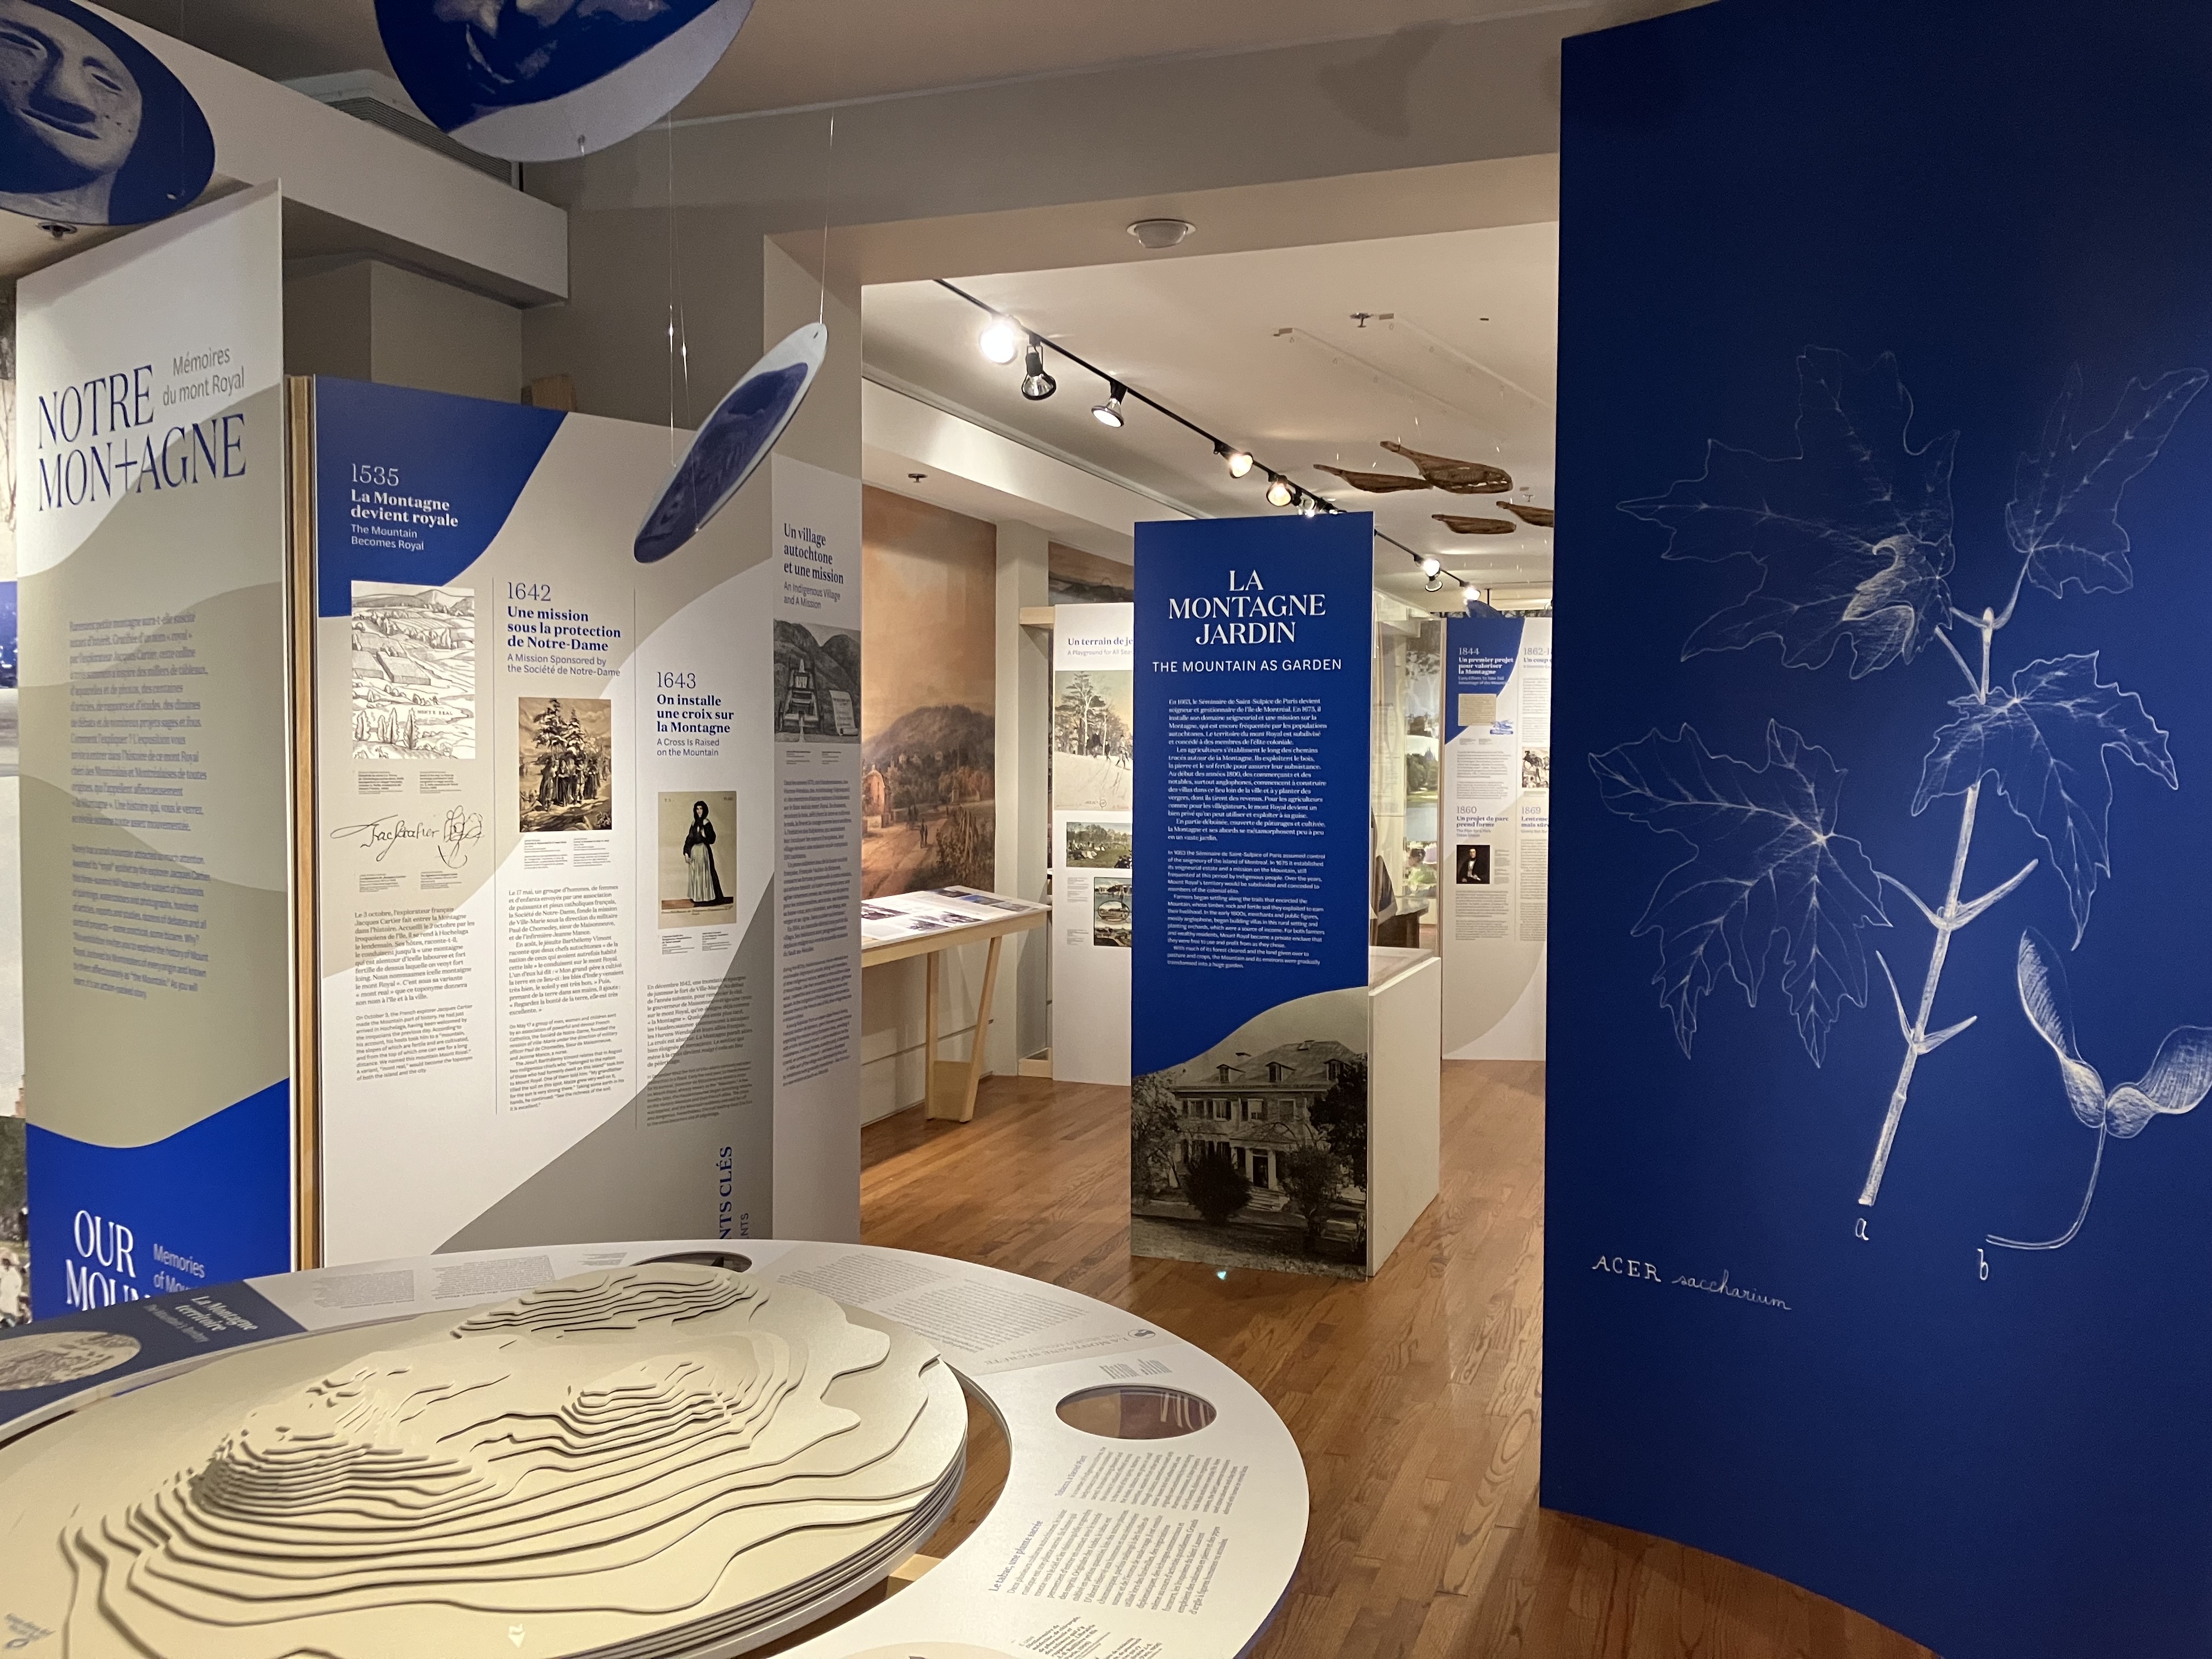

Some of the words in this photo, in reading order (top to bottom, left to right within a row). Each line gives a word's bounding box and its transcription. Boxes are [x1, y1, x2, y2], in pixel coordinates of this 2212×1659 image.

[173, 347, 230, 376] Mémoires
[163, 385, 176, 406] du
[179, 381, 210, 403] mont
[212, 366, 245, 397] Royal
[38, 364, 154, 449] NOTRE
[352, 464, 399, 486] 1535
[352, 489, 370, 503] La
[374, 492, 450, 512] Montagne
[351, 505, 410, 522] devient
[413, 514, 459, 528] royale
[351, 524, 369, 534] The
[371, 526, 417, 538] Mountain
[784, 523, 796, 539] Un
[798, 527, 826, 549] village
[351, 536, 396, 548] Becomes
[399, 539, 424, 551] Royal
[784, 545, 832, 565] autochtone
[784, 562, 793, 574] et
[794, 565, 810, 577] une
[812, 566, 843, 584] mission
[1229, 569, 1264, 591] LA
[507, 582, 551, 601] 1642
[784, 581, 792, 591] An
[793, 584, 823, 596] Indigenous
[823, 589, 840, 602] Village
[784, 595, 795, 605] and
[795, 597, 800, 605] A
[800, 597, 821, 609] Mission
[1169, 594, 1326, 619] MONTAGNE
[508, 606, 534, 618] Une
[538, 608, 588, 622] mission
[507, 624, 537, 633] sous
[540, 622, 551, 634] la
[554, 626, 620, 637] protection
[1195, 622, 1295, 645] JARDIN
[507, 635, 524, 647] de
[528, 636, 608, 651] Notre-Dame
[507, 663, 522, 673] the
[524, 664, 556, 673] Société
[557, 665, 568, 674] de
[570, 666, 620, 676] Notre-Dame
[516, 653, 549, 663] Mission
[550, 654, 595, 665] Sponsored
[597, 657, 606, 667] by
[1152, 661, 1178, 672] THE
[1183, 661, 1256, 672] MOUNTAIN
[1261, 660, 1278, 671] AS
[1282, 659, 1341, 670] GARDEN
[657, 672, 696, 689] 1643
[657, 694, 674, 704] On
[678, 694, 721, 706] installe
[657, 710, 679, 719] une
[682, 709, 713, 719] croix
[657, 721, 668, 732] la
[670, 721, 730, 736] Montagne
[664, 738, 685, 746] Cross
[668, 748, 681, 756] the
[1457, 806, 1477, 814] 1860
[716, 1146, 732, 1197] CLÉS
[1855, 1217, 1869, 1240] a
[74, 1210, 136, 1278] OUR
[153, 1243, 205, 1279] Memories
[1592, 1255, 1661, 1283] ACER
[1977, 1249, 1989, 1280] b
[153, 1271, 165, 1289] of
